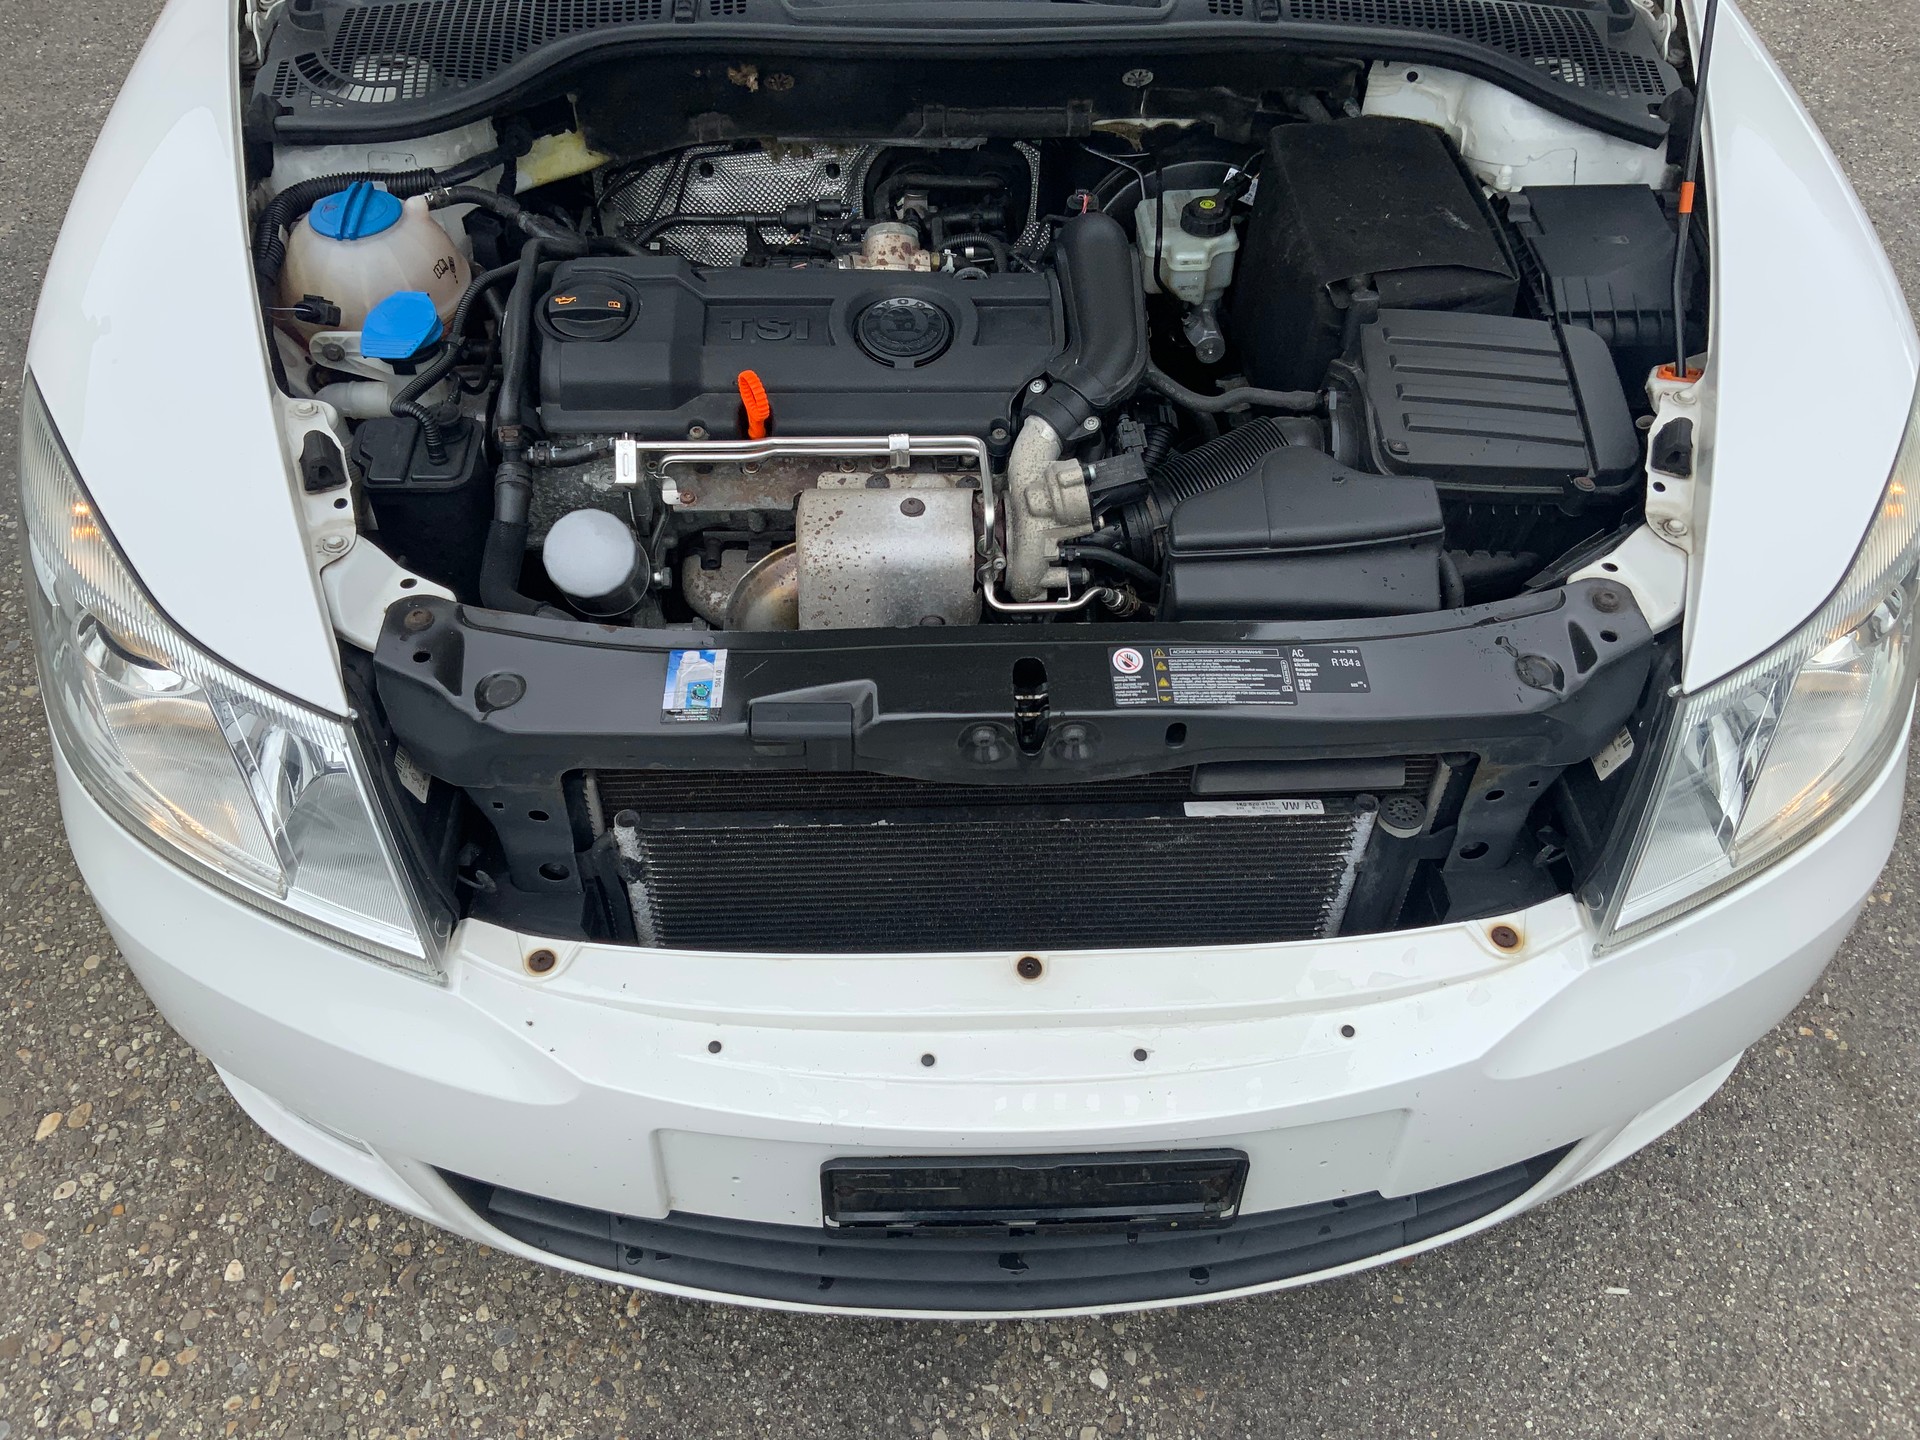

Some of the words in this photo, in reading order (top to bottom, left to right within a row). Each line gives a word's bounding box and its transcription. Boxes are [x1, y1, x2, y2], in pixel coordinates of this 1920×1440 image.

[720, 317, 810, 341] TSI
[1291, 649, 1304, 657] AC
[1282, 801, 1300, 811] VW
[1304, 801, 1319, 810] AG
